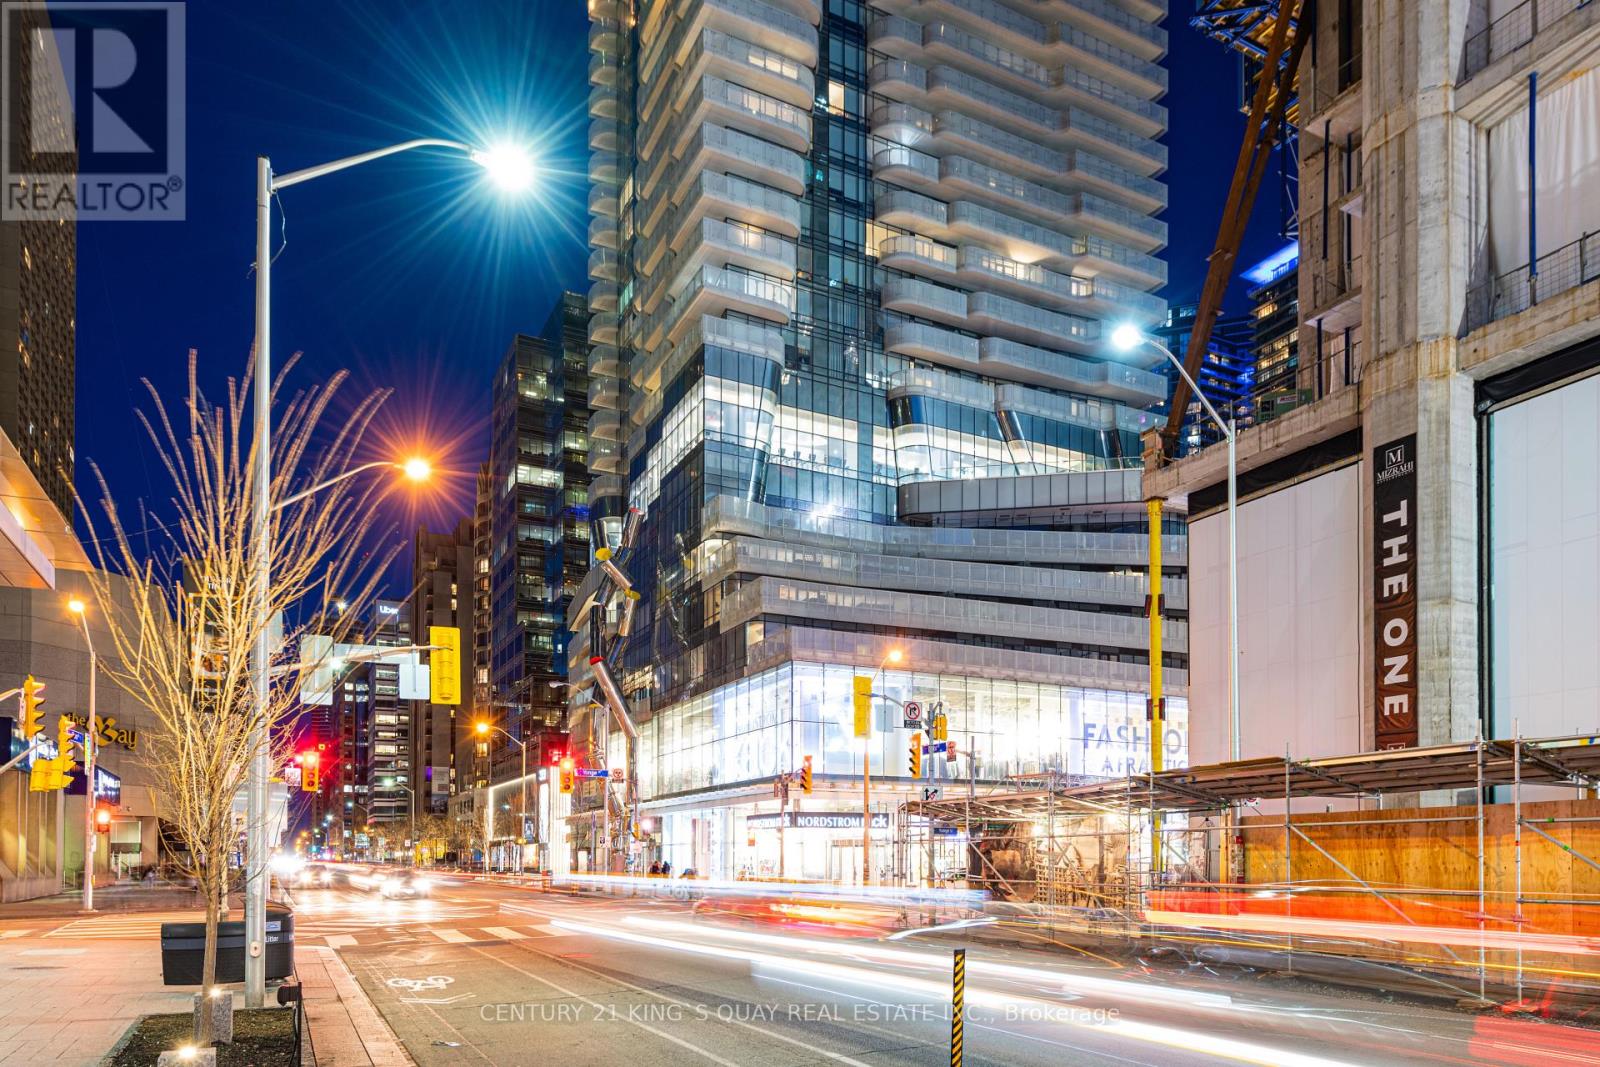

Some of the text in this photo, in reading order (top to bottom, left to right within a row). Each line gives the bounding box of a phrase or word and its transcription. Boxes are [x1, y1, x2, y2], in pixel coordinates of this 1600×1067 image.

[1388, 449, 1402, 466] M
[1376, 461, 1414, 481] MIZRAHI
[1382, 499, 1408, 598] THE
[1382, 617, 1409, 716] ONE
[796, 815, 860, 828] NORDSTROM
